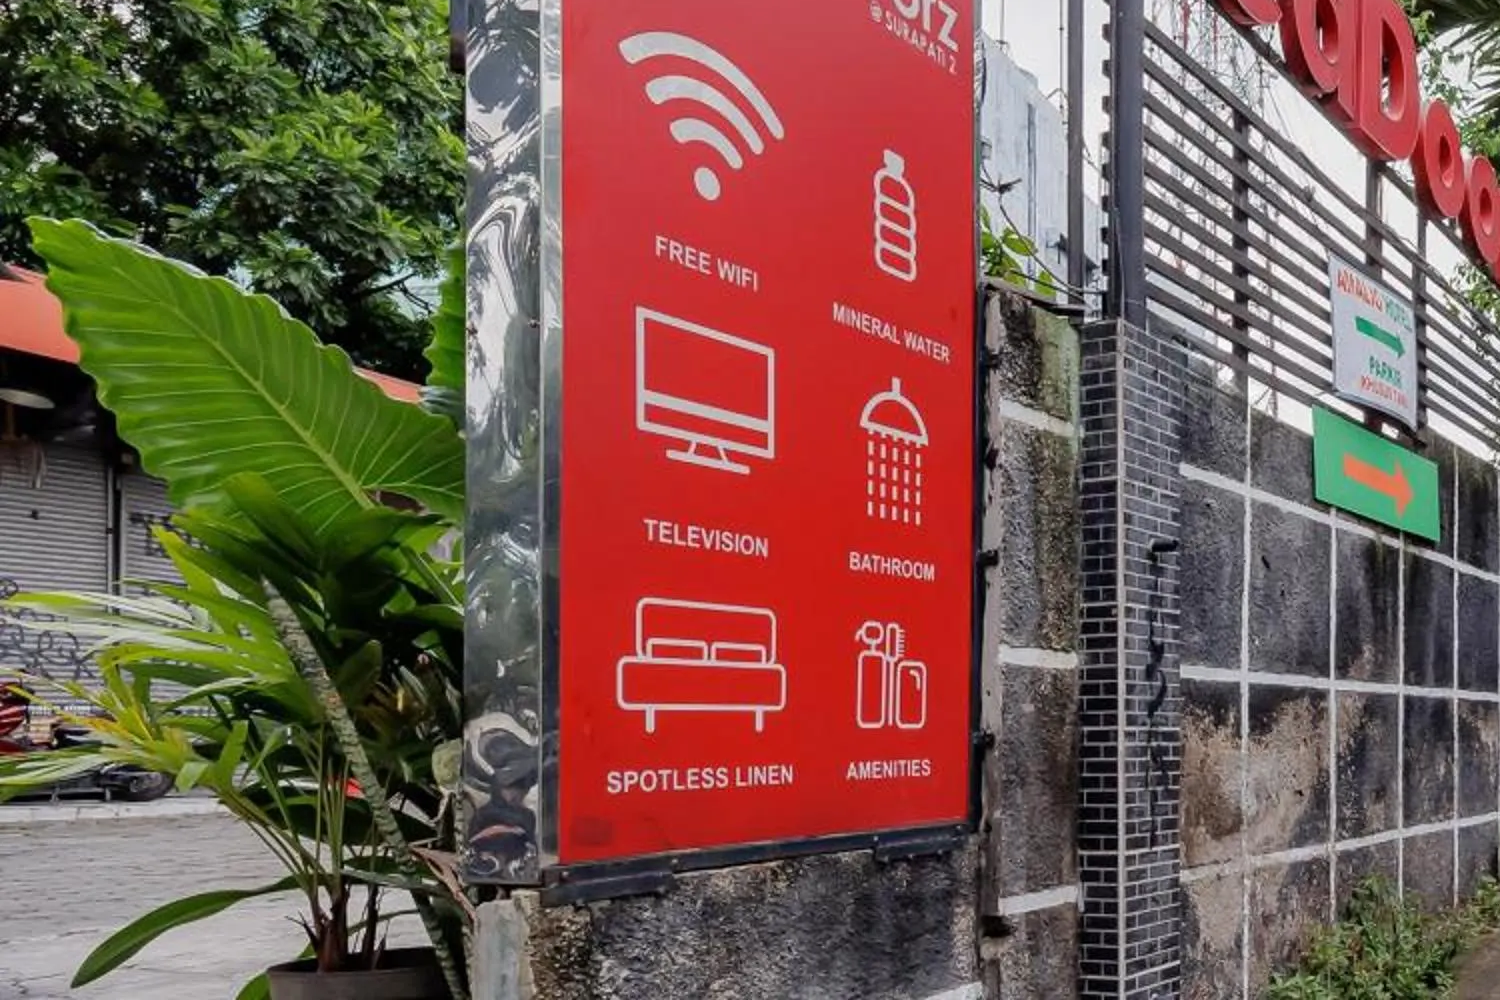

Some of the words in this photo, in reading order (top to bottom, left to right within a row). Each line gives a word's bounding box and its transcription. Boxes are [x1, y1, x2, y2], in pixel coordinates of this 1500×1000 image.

[885, 10, 946, 68] SURAPATI
[948, 54, 958, 75] 2
[655, 235, 712, 275] FREE
[717, 258, 758, 292] WIFI
[832, 302, 901, 345] MINERAL
[903, 330, 951, 364] WATER
[643, 519, 769, 559] TELEVISION
[848, 551, 936, 583] BATHROOM
[606, 767, 729, 794] SPOTLESS
[735, 764, 794, 788] LINEN
[846, 758, 932, 781] AMENITIES
